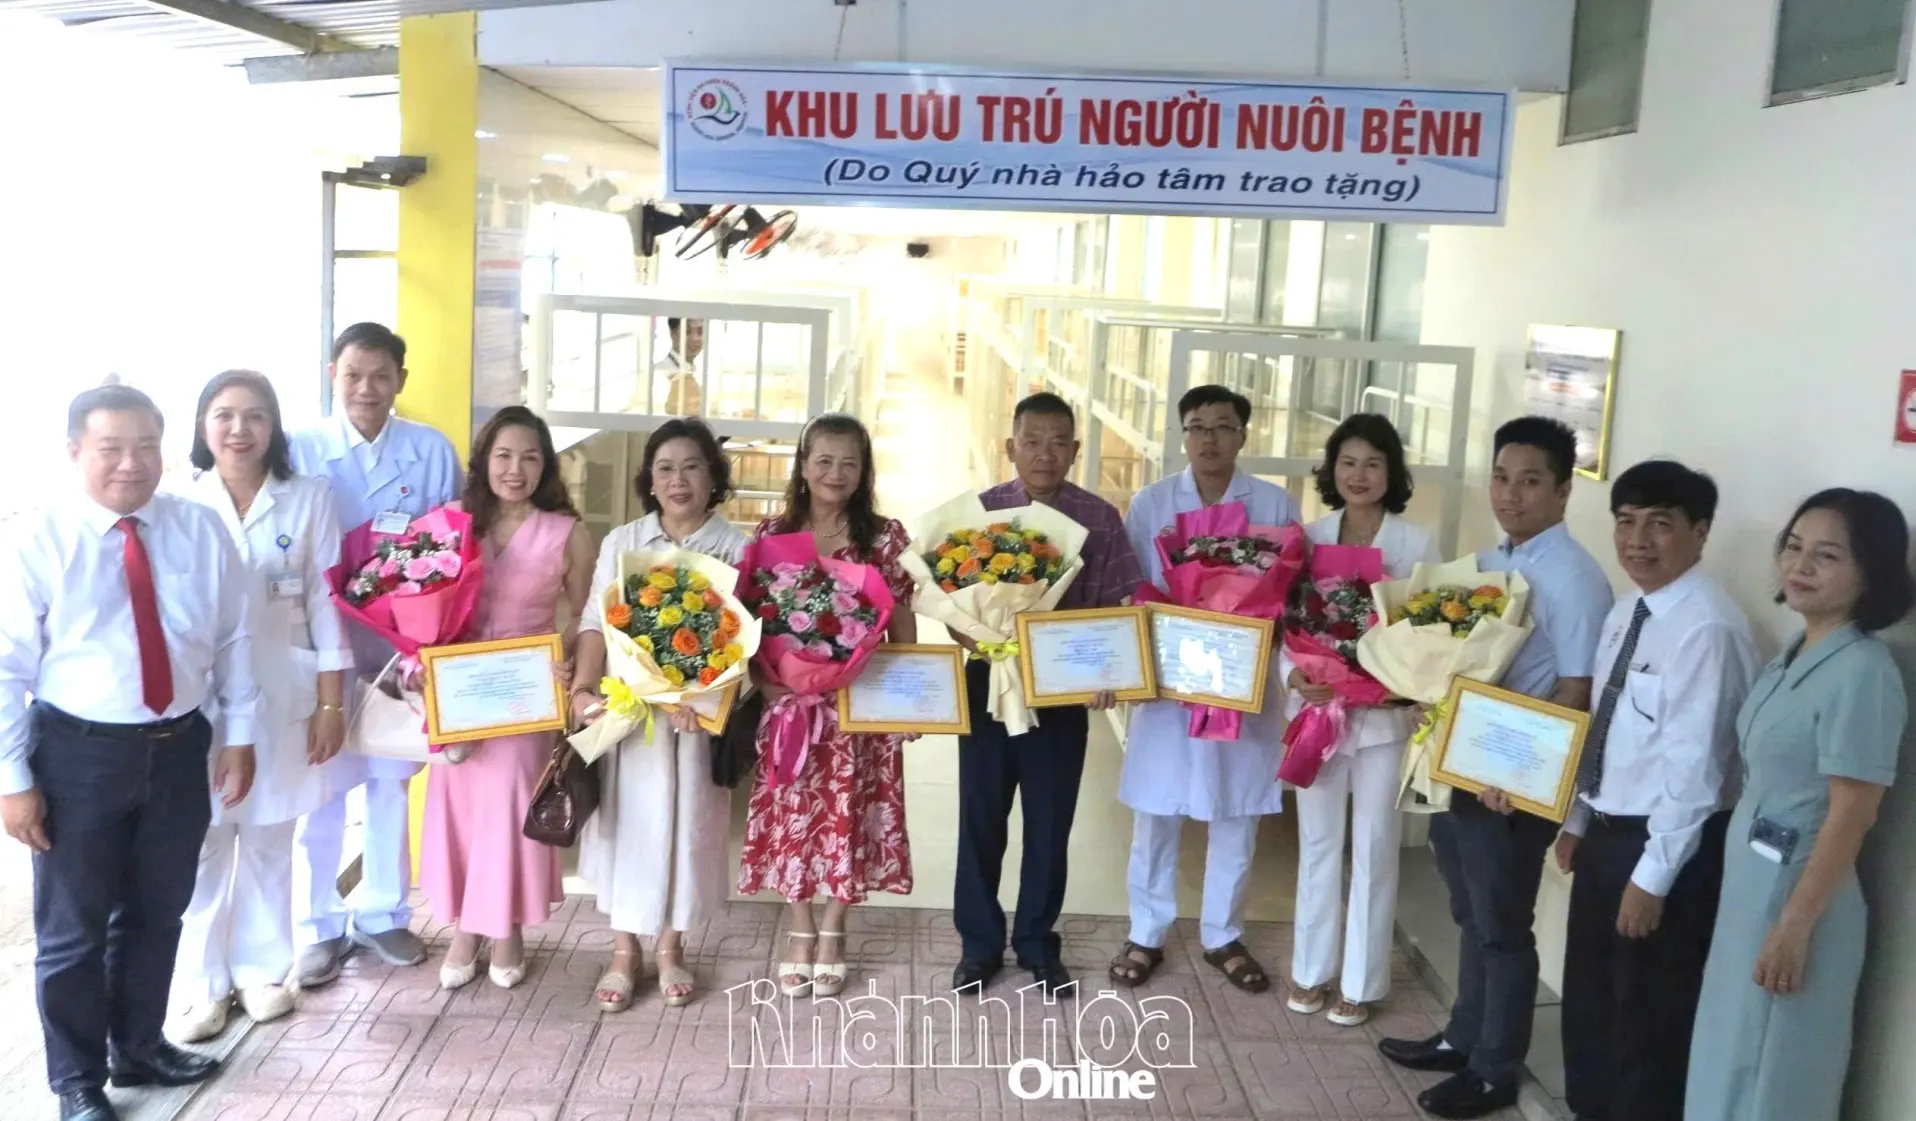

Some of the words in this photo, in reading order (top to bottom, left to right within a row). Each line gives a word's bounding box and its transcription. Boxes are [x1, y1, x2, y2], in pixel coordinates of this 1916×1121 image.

[765, 90, 858, 139] KHU
[874, 90, 962, 142] LƯU
[976, 87, 1063, 145] TRÚ
[1079, 89, 1221, 149] NGƯỜI
[1235, 96, 1346, 153] NUÔI
[1360, 99, 1482, 166] BỆNH
[824, 157, 891, 186] (Do
[991, 164, 1063, 187] nhà
[1074, 163, 1145, 190] hảo
[1156, 167, 1226, 192] tâm
[1239, 174, 1313, 194] trao
[1325, 173, 1422, 202] tặng)
